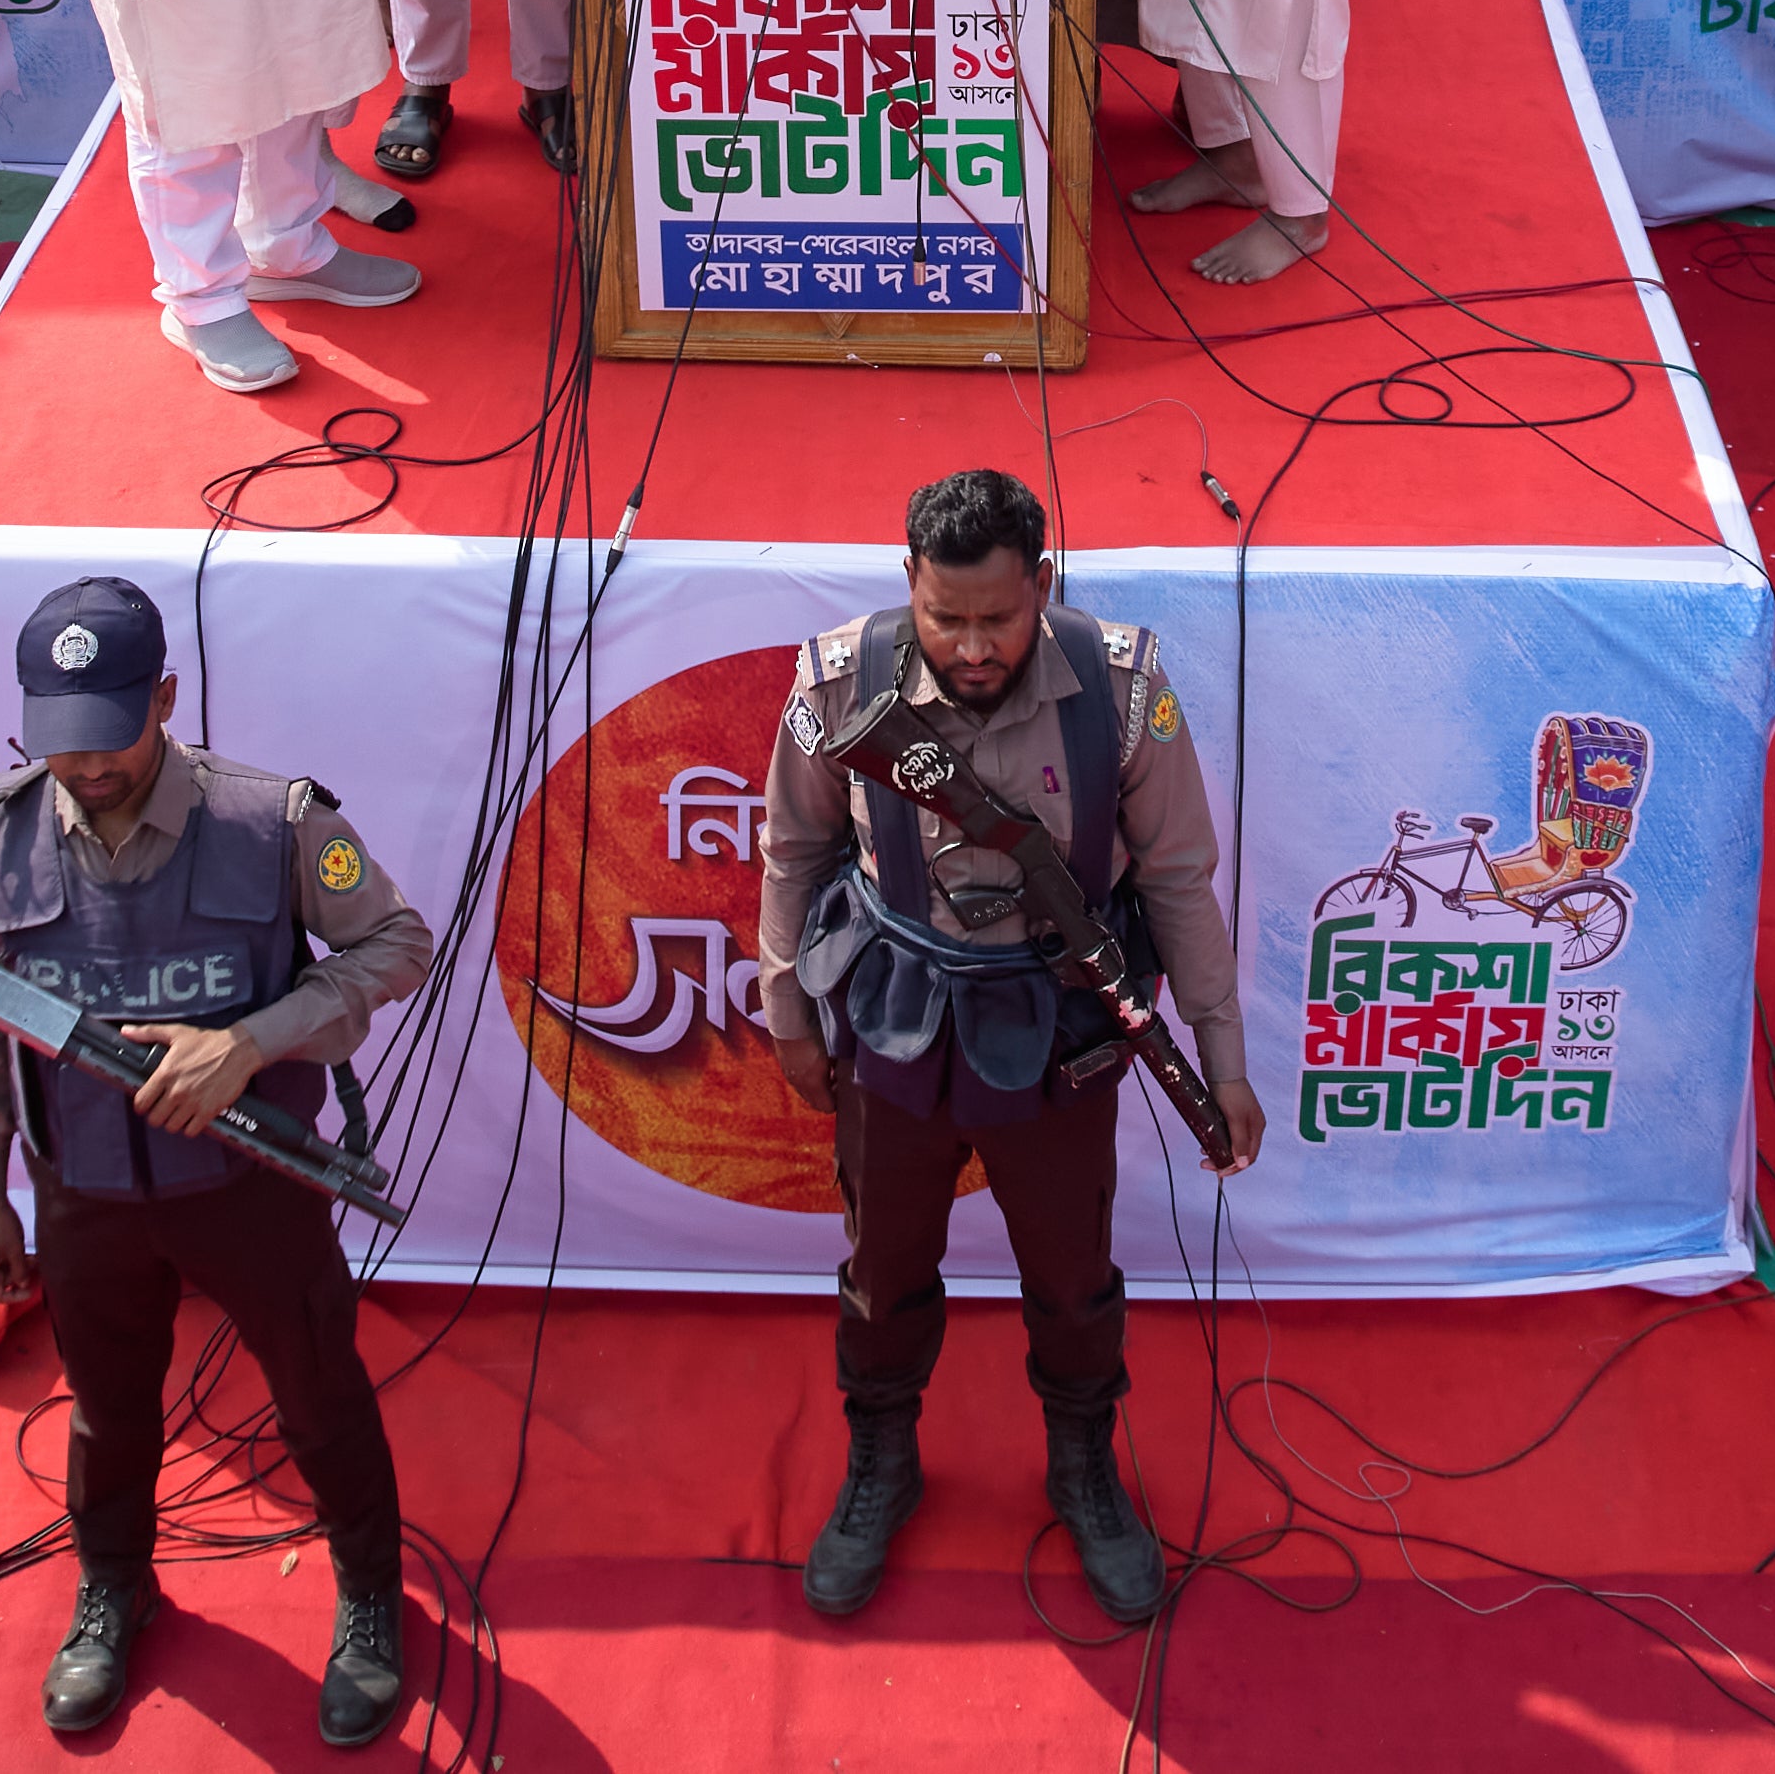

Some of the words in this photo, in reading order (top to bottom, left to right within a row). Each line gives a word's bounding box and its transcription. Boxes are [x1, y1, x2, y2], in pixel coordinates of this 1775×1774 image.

[947, 12, 1024, 46] ঢাকা
[654, 14, 936, 132] মার্কায়
[949, 42, 1019, 82] ১৩
[937, 234, 997, 258] নগর
[1307, 913, 1555, 1010] রিকশা
[1555, 988, 1621, 1018] ঢাকা
[1304, 990, 1545, 1078] মার্কায়
[1557, 1015, 1616, 1043] ১৩
[1550, 1040, 1612, 1064] আসনে
